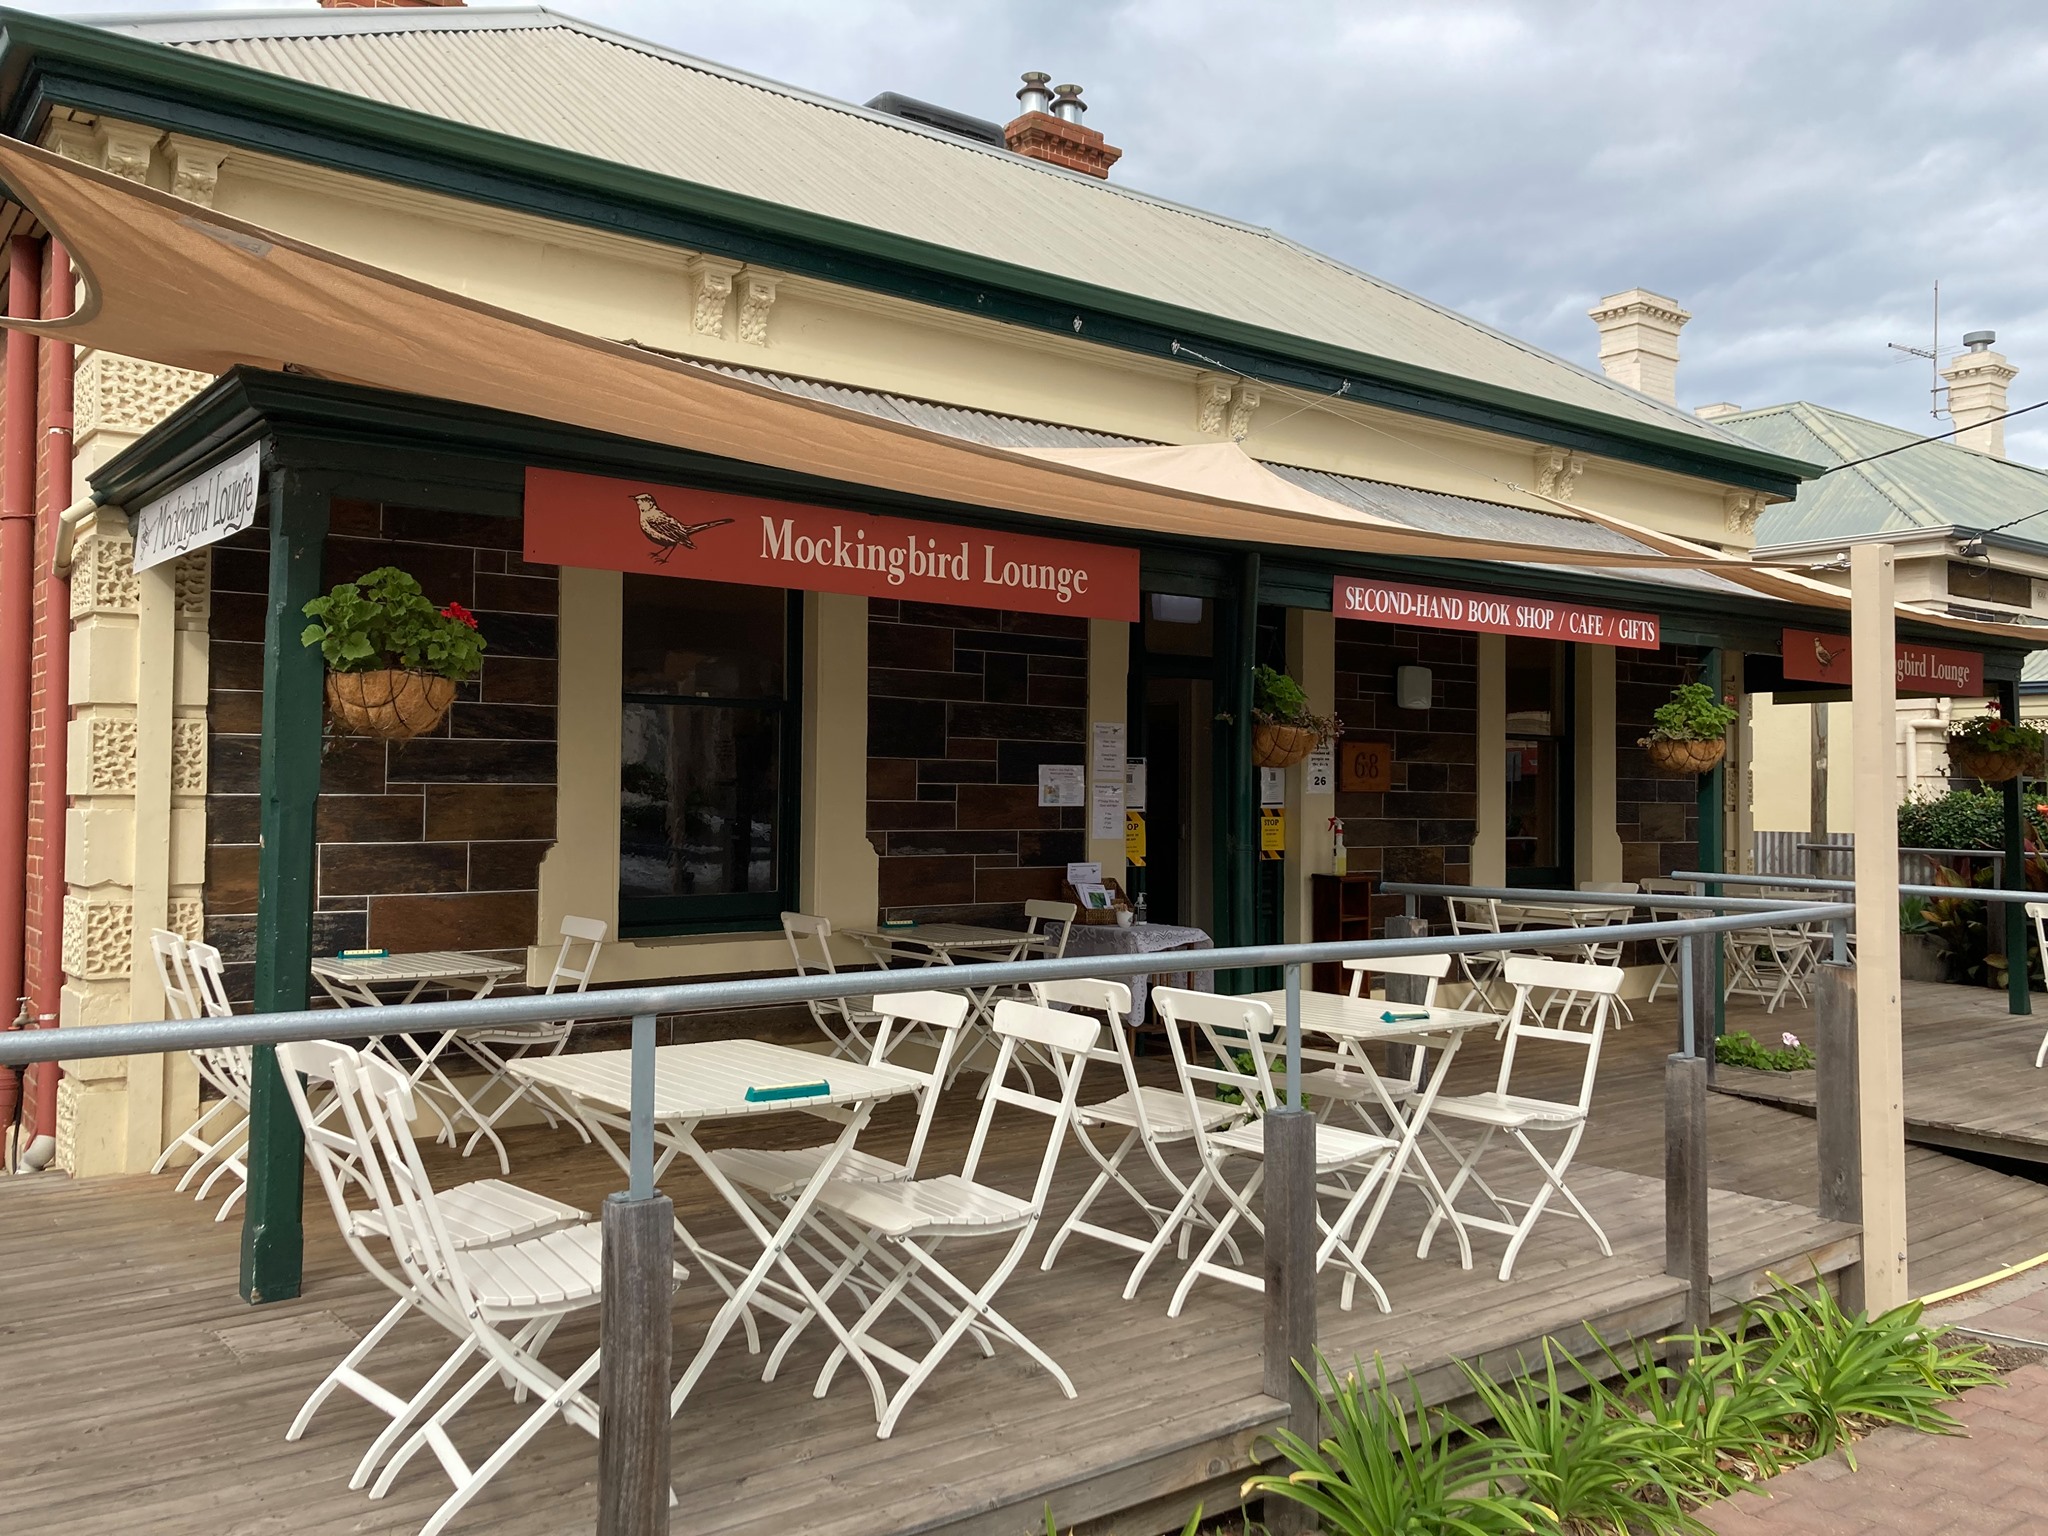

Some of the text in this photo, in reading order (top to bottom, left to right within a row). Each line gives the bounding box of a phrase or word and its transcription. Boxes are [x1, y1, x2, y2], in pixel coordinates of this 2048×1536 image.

[152, 471, 253, 554] Mockingbird Lounge
[760, 515, 1088, 603] Mockingbird Lounge
[1345, 586, 1462, 621] SECOND-HAND
[1467, 599, 1511, 626] BOOK
[1516, 606, 1554, 631] SHOP
[1569, 612, 1604, 637] CAFE
[1619, 618, 1655, 643] GIFTS
[1896, 651, 1970, 688] gbird Lounge
[1314, 776, 1326, 786] 26
[1127, 823, 1139, 831] OP
